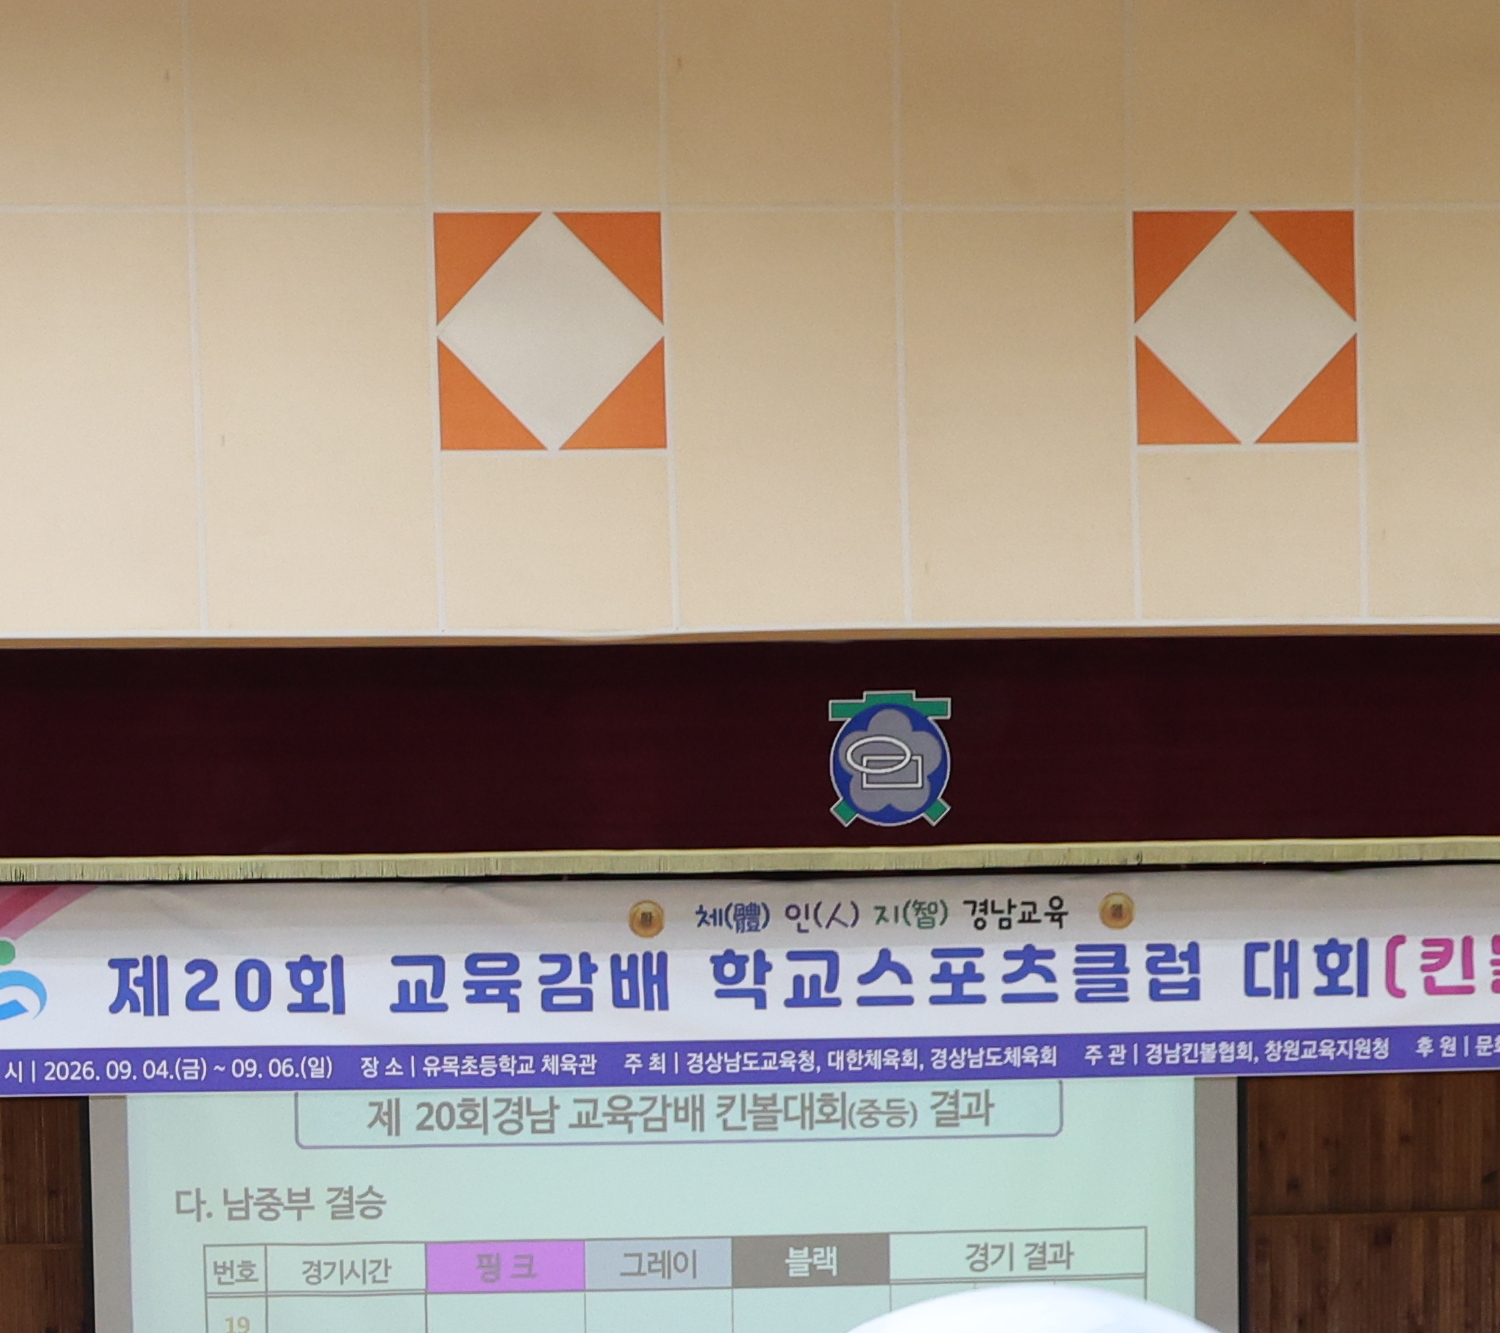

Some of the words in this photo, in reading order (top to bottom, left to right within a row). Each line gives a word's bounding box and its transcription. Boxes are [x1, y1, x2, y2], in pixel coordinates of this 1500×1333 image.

[784, 899, 860, 933] 인(人)
[962, 896, 1069, 930] 경남교육
[107, 952, 347, 1018] 제20회
[388, 949, 671, 1014] 교육감배
[709, 938, 1203, 1012] 학교스포츠클럽
[43, 1059, 101, 1082] 2026.
[106, 1058, 137, 1081] 09.
[142, 1056, 208, 1082] 04.(금)
[231, 1057, 263, 1080] 09.
[268, 1055, 334, 1080] 06.(일)
[421, 1053, 536, 1079] 유목초등학교
[541, 1053, 597, 1077] 체육관
[686, 1049, 822, 1075] 경상남도교육청,
[827, 1048, 925, 1073] 대한체육회,
[930, 1045, 1058, 1072] 경상남도체육회
[1145, 1039, 1260, 1068] 경남킨볼협회,
[1264, 1036, 1391, 1064] 창원교육지원청
[367, 1100, 401, 1137] 제
[414, 1095, 560, 1136] 20회경남
[567, 1094, 703, 1135] 교육감배
[714, 1091, 920, 1132] 킨볼대회(중등)
[929, 1088, 995, 1128] 결과
[174, 1188, 214, 1222] 다.
[222, 1186, 316, 1222] 남중부
[326, 1185, 388, 1221] 결승
[212, 1258, 260, 1285] 번호
[300, 1257, 393, 1287] 경기시간
[619, 1248, 699, 1281] 그레이
[784, 1245, 839, 1278] 블랙
[964, 1240, 1017, 1273] 경기
[1023, 1238, 1075, 1271] 결과
